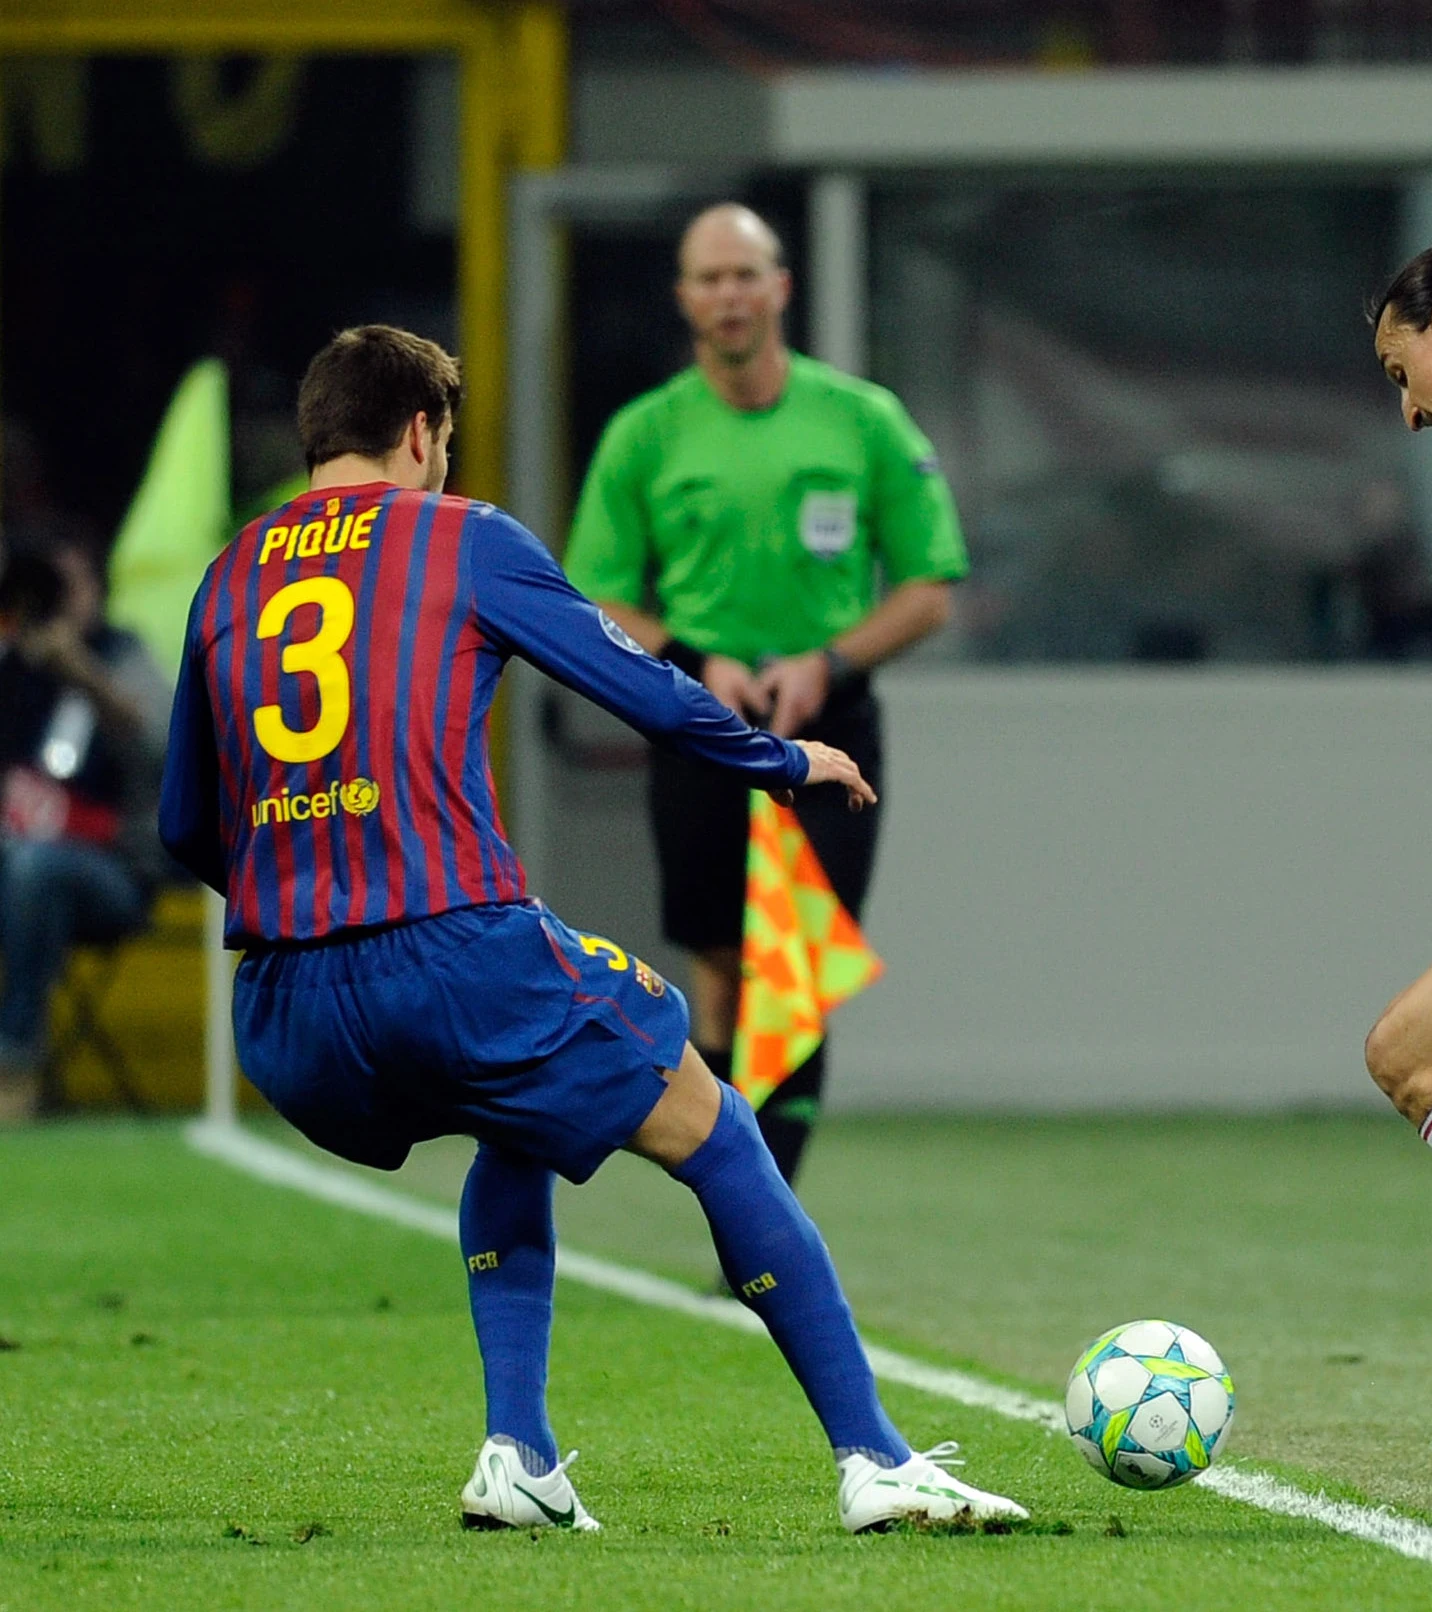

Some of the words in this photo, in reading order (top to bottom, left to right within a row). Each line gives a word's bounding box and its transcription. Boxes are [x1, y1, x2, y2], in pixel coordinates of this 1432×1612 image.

[258, 506, 383, 565] PIQUÉ
[253, 576, 355, 764] 3
[251, 780, 341, 828] unicef
[578, 934, 629, 971] 3
[742, 1272, 778, 1299] FCB
